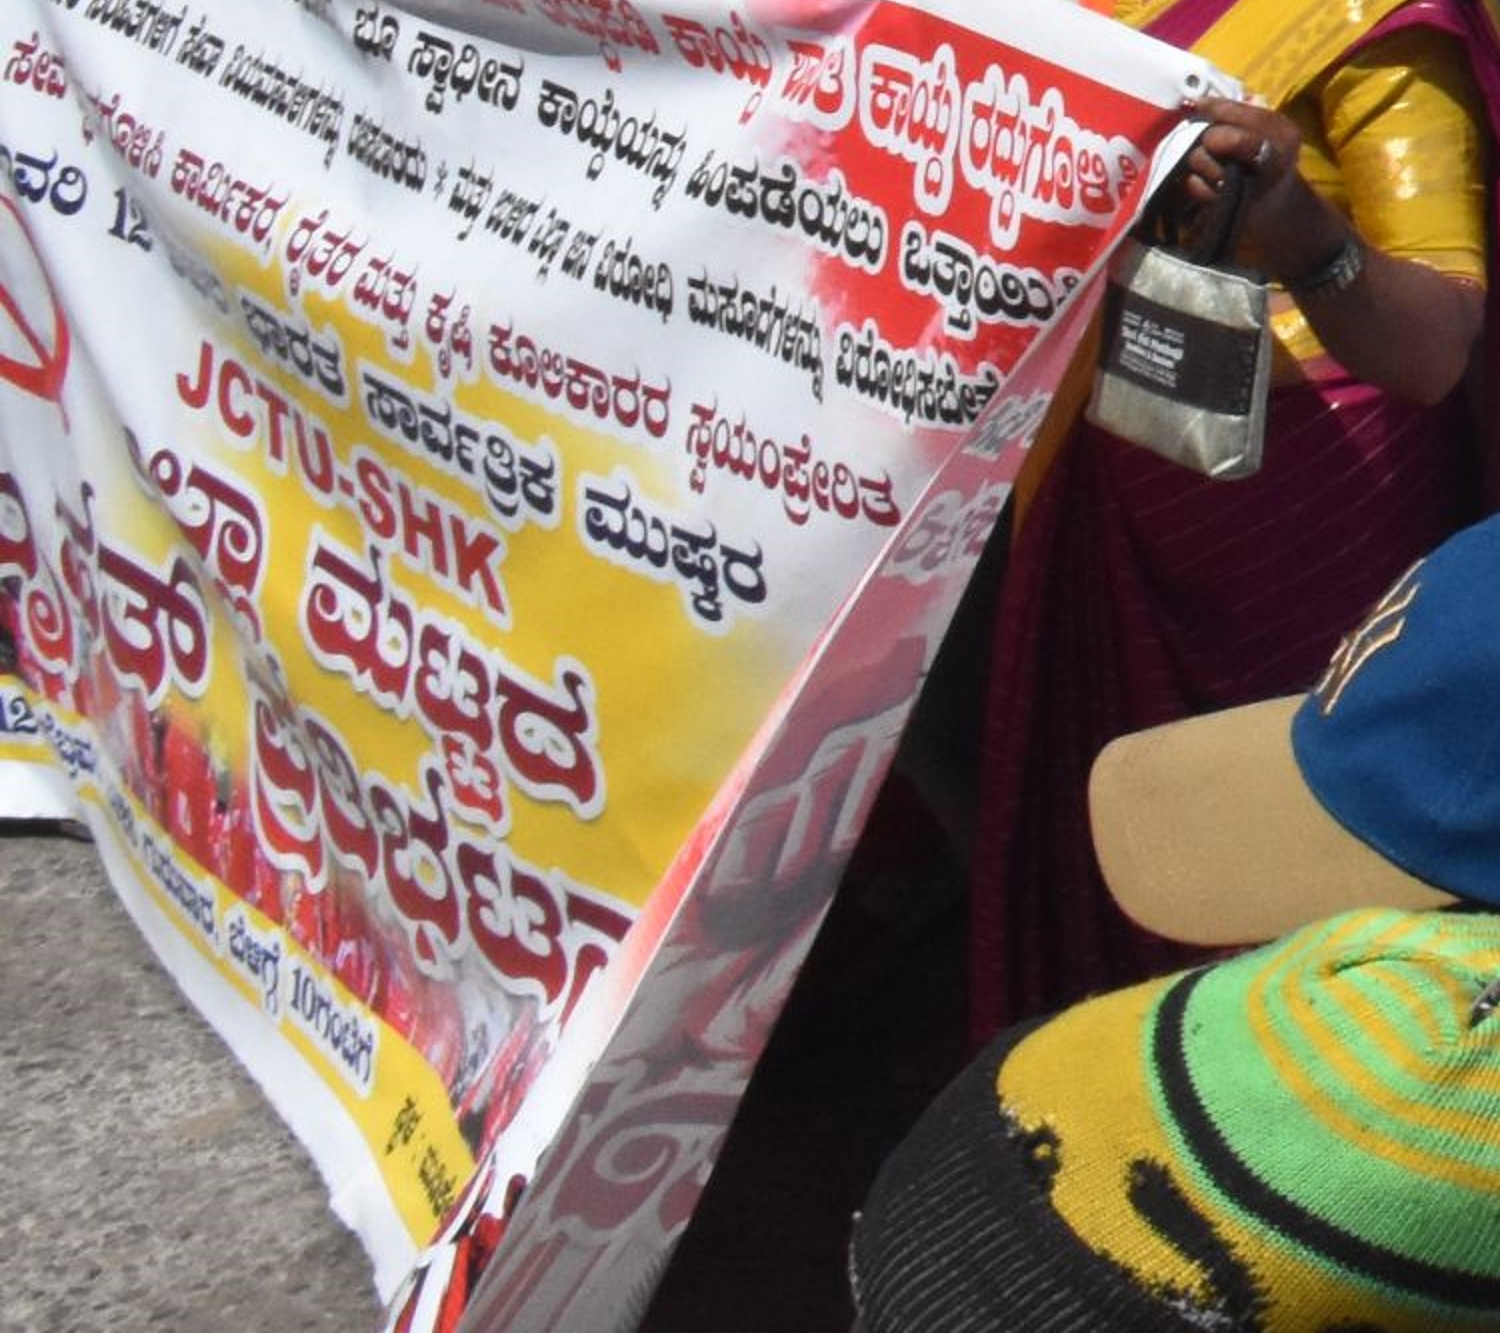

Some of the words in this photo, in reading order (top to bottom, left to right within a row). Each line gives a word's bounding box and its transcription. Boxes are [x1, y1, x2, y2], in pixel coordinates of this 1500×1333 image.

[408, 33, 525, 115] ಸ್ವಾಧೀನ
[537, 85, 689, 212] ಕಾಯ್ದೆಯನ್ನು
[684, 148, 885, 266] ಹಿಂಪಡೆಯಲು
[0, 143, 88, 216] ವರಿ
[362, 371, 556, 518] ಸಾರ್ವತ್ರಿಕ
[585, 479, 769, 623] ಮುಷ್ಕರ
[176, 340, 507, 616] JCTU-SHK
[489, 315, 673, 438] ಕೂಲಿಕಾರರ
[685, 389, 902, 530] ಸ್ವಯಂಪ್ರೇರಿತ
[834, 327, 1000, 426] ವಿರೋಧಿಸಬೇಕೆ
[125, 426, 263, 645] ಲ್ಲಾ
[306, 545, 600, 828] ಮಟ್ಟದ
